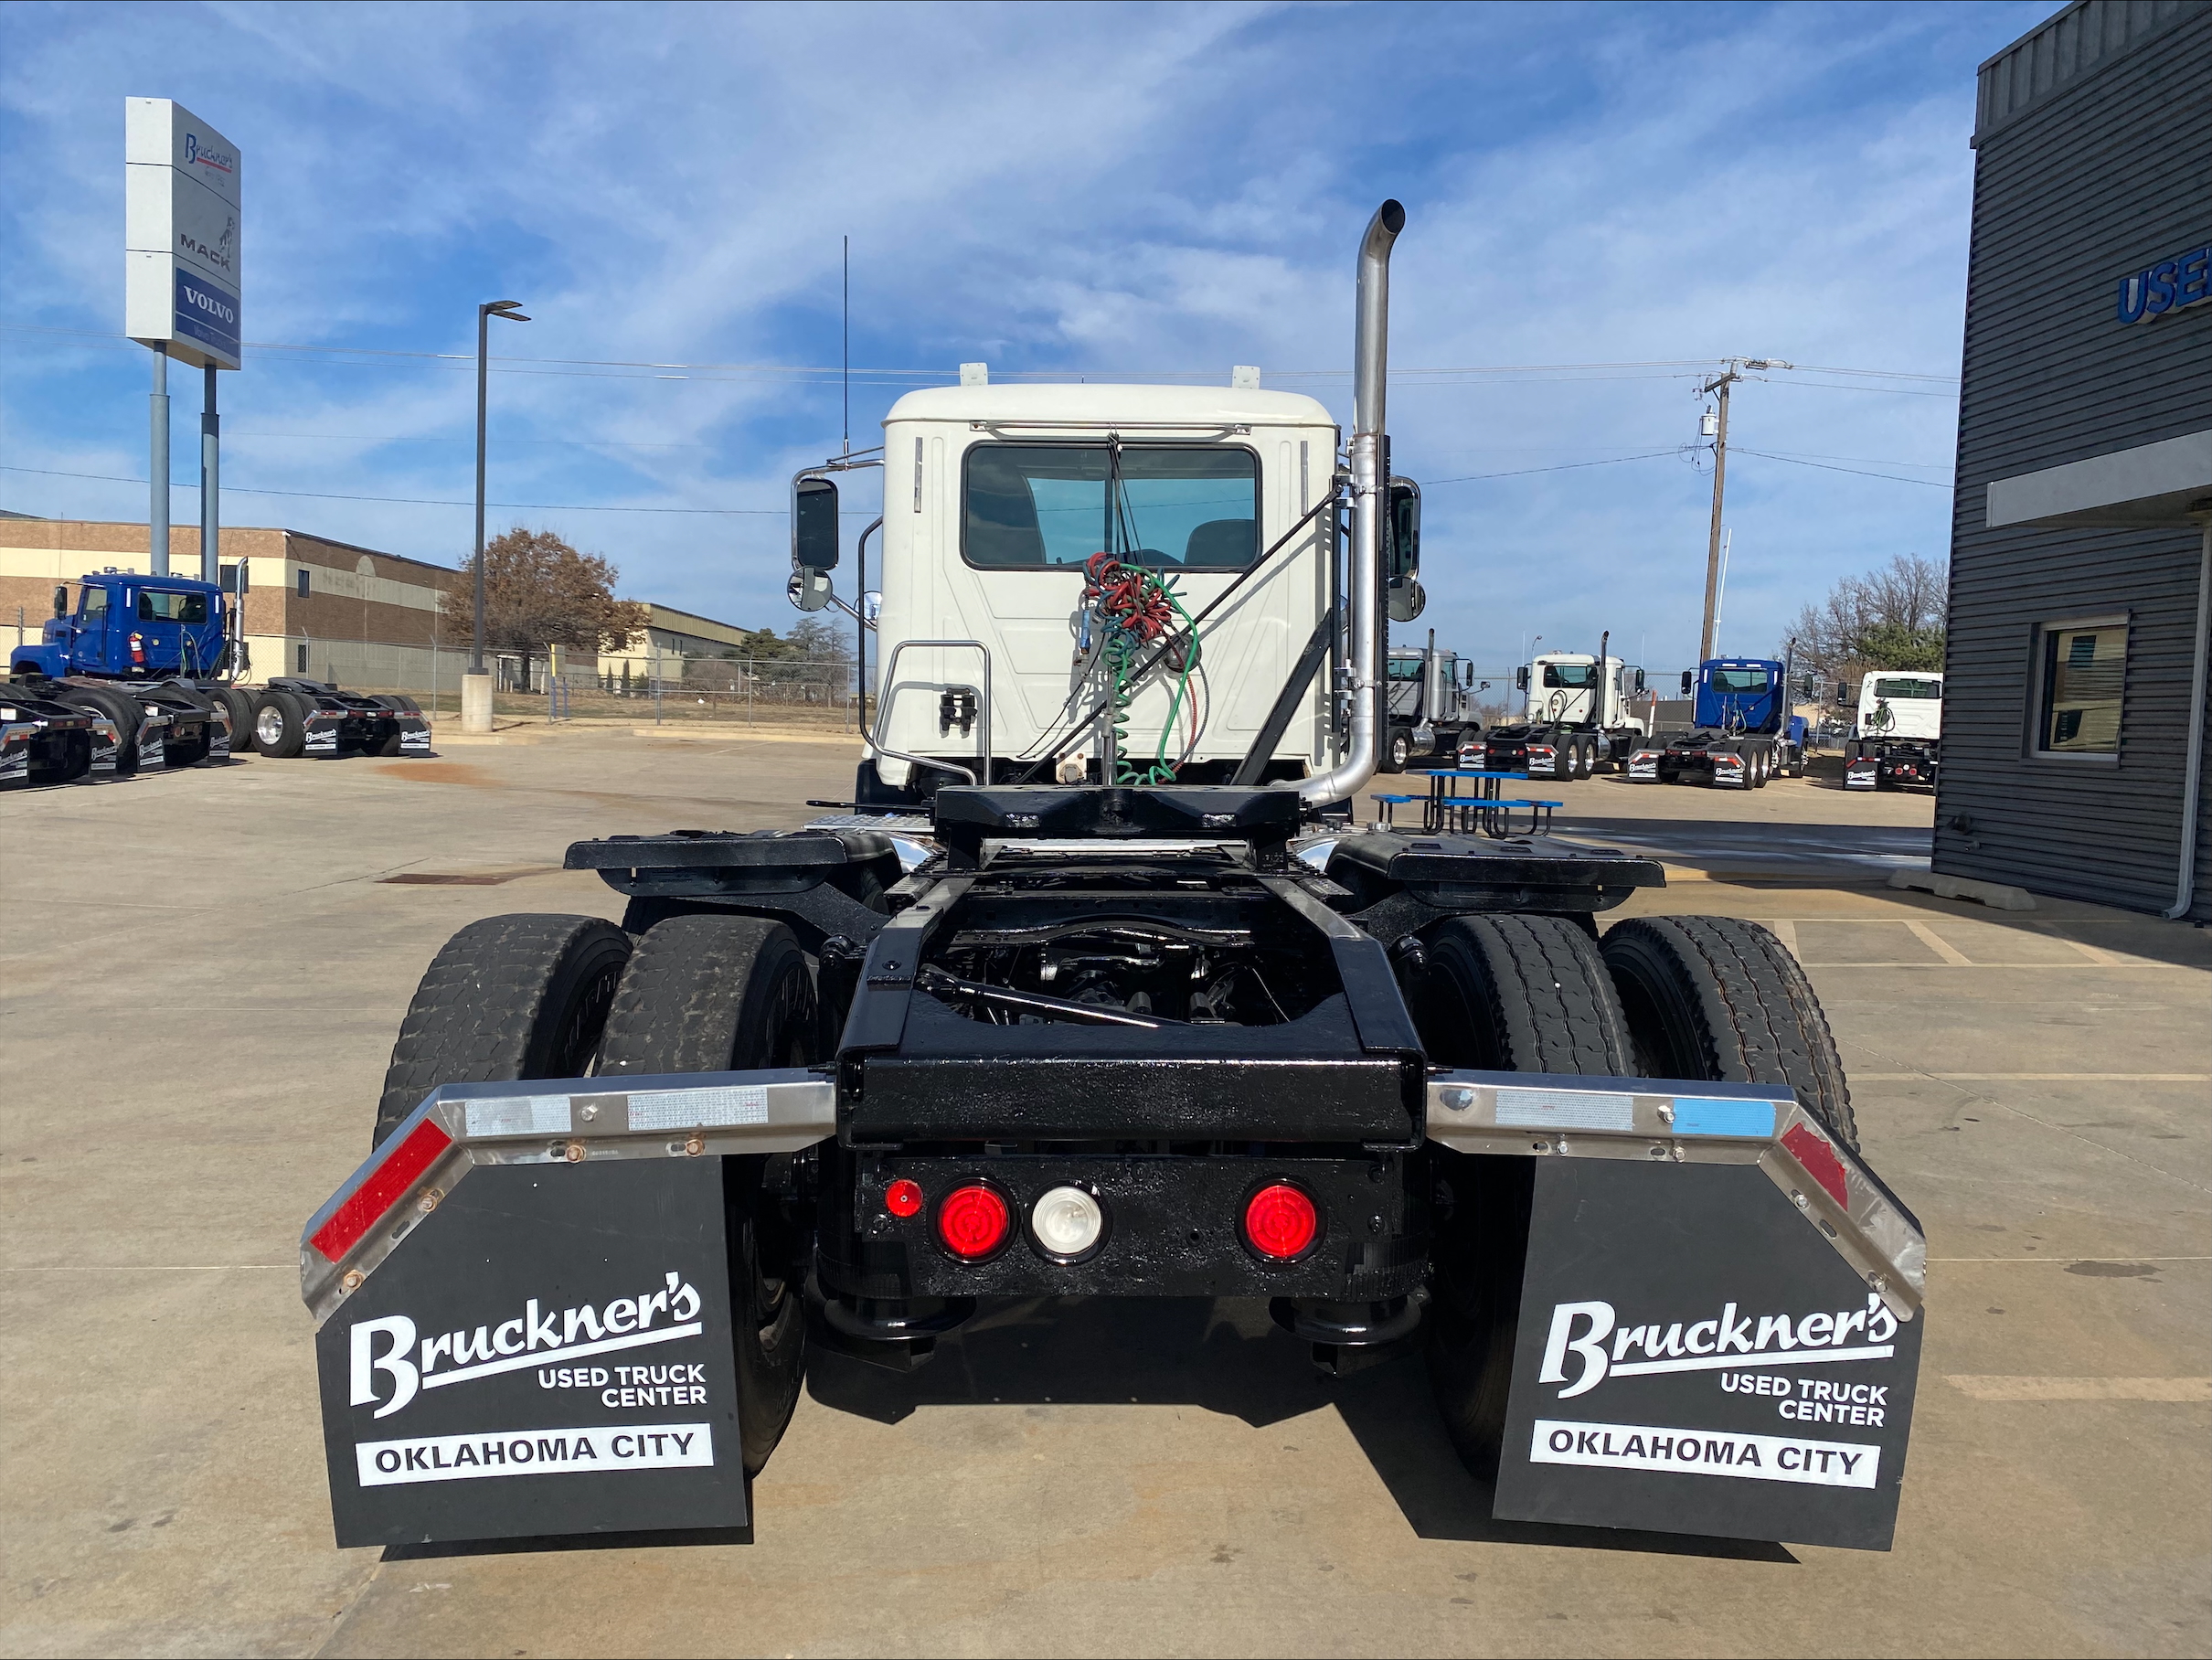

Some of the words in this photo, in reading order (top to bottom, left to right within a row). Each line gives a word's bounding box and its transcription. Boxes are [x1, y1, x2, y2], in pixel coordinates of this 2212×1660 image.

[180, 233, 230, 272] MACK
[183, 285, 234, 324] VOLVO
[2118, 247, 2212, 325] USE
[350, 1272, 702, 1419] Bruckner's
[1539, 1293, 1898, 1399] Bruckner's
[538, 1367, 610, 1389] USED
[614, 1364, 706, 1386] TRUCK
[1721, 1373, 1792, 1396] USED
[1797, 1379, 1888, 1406] TRUCK
[601, 1386, 707, 1408] CENTER
[1778, 1399, 1885, 1428] CENTER
[375, 1438, 599, 1474] OKLAHOMA
[611, 1432, 695, 1458] CITY
[1548, 1429, 1762, 1467] OKLAHOMA
[1777, 1447, 1864, 1475] CITY
